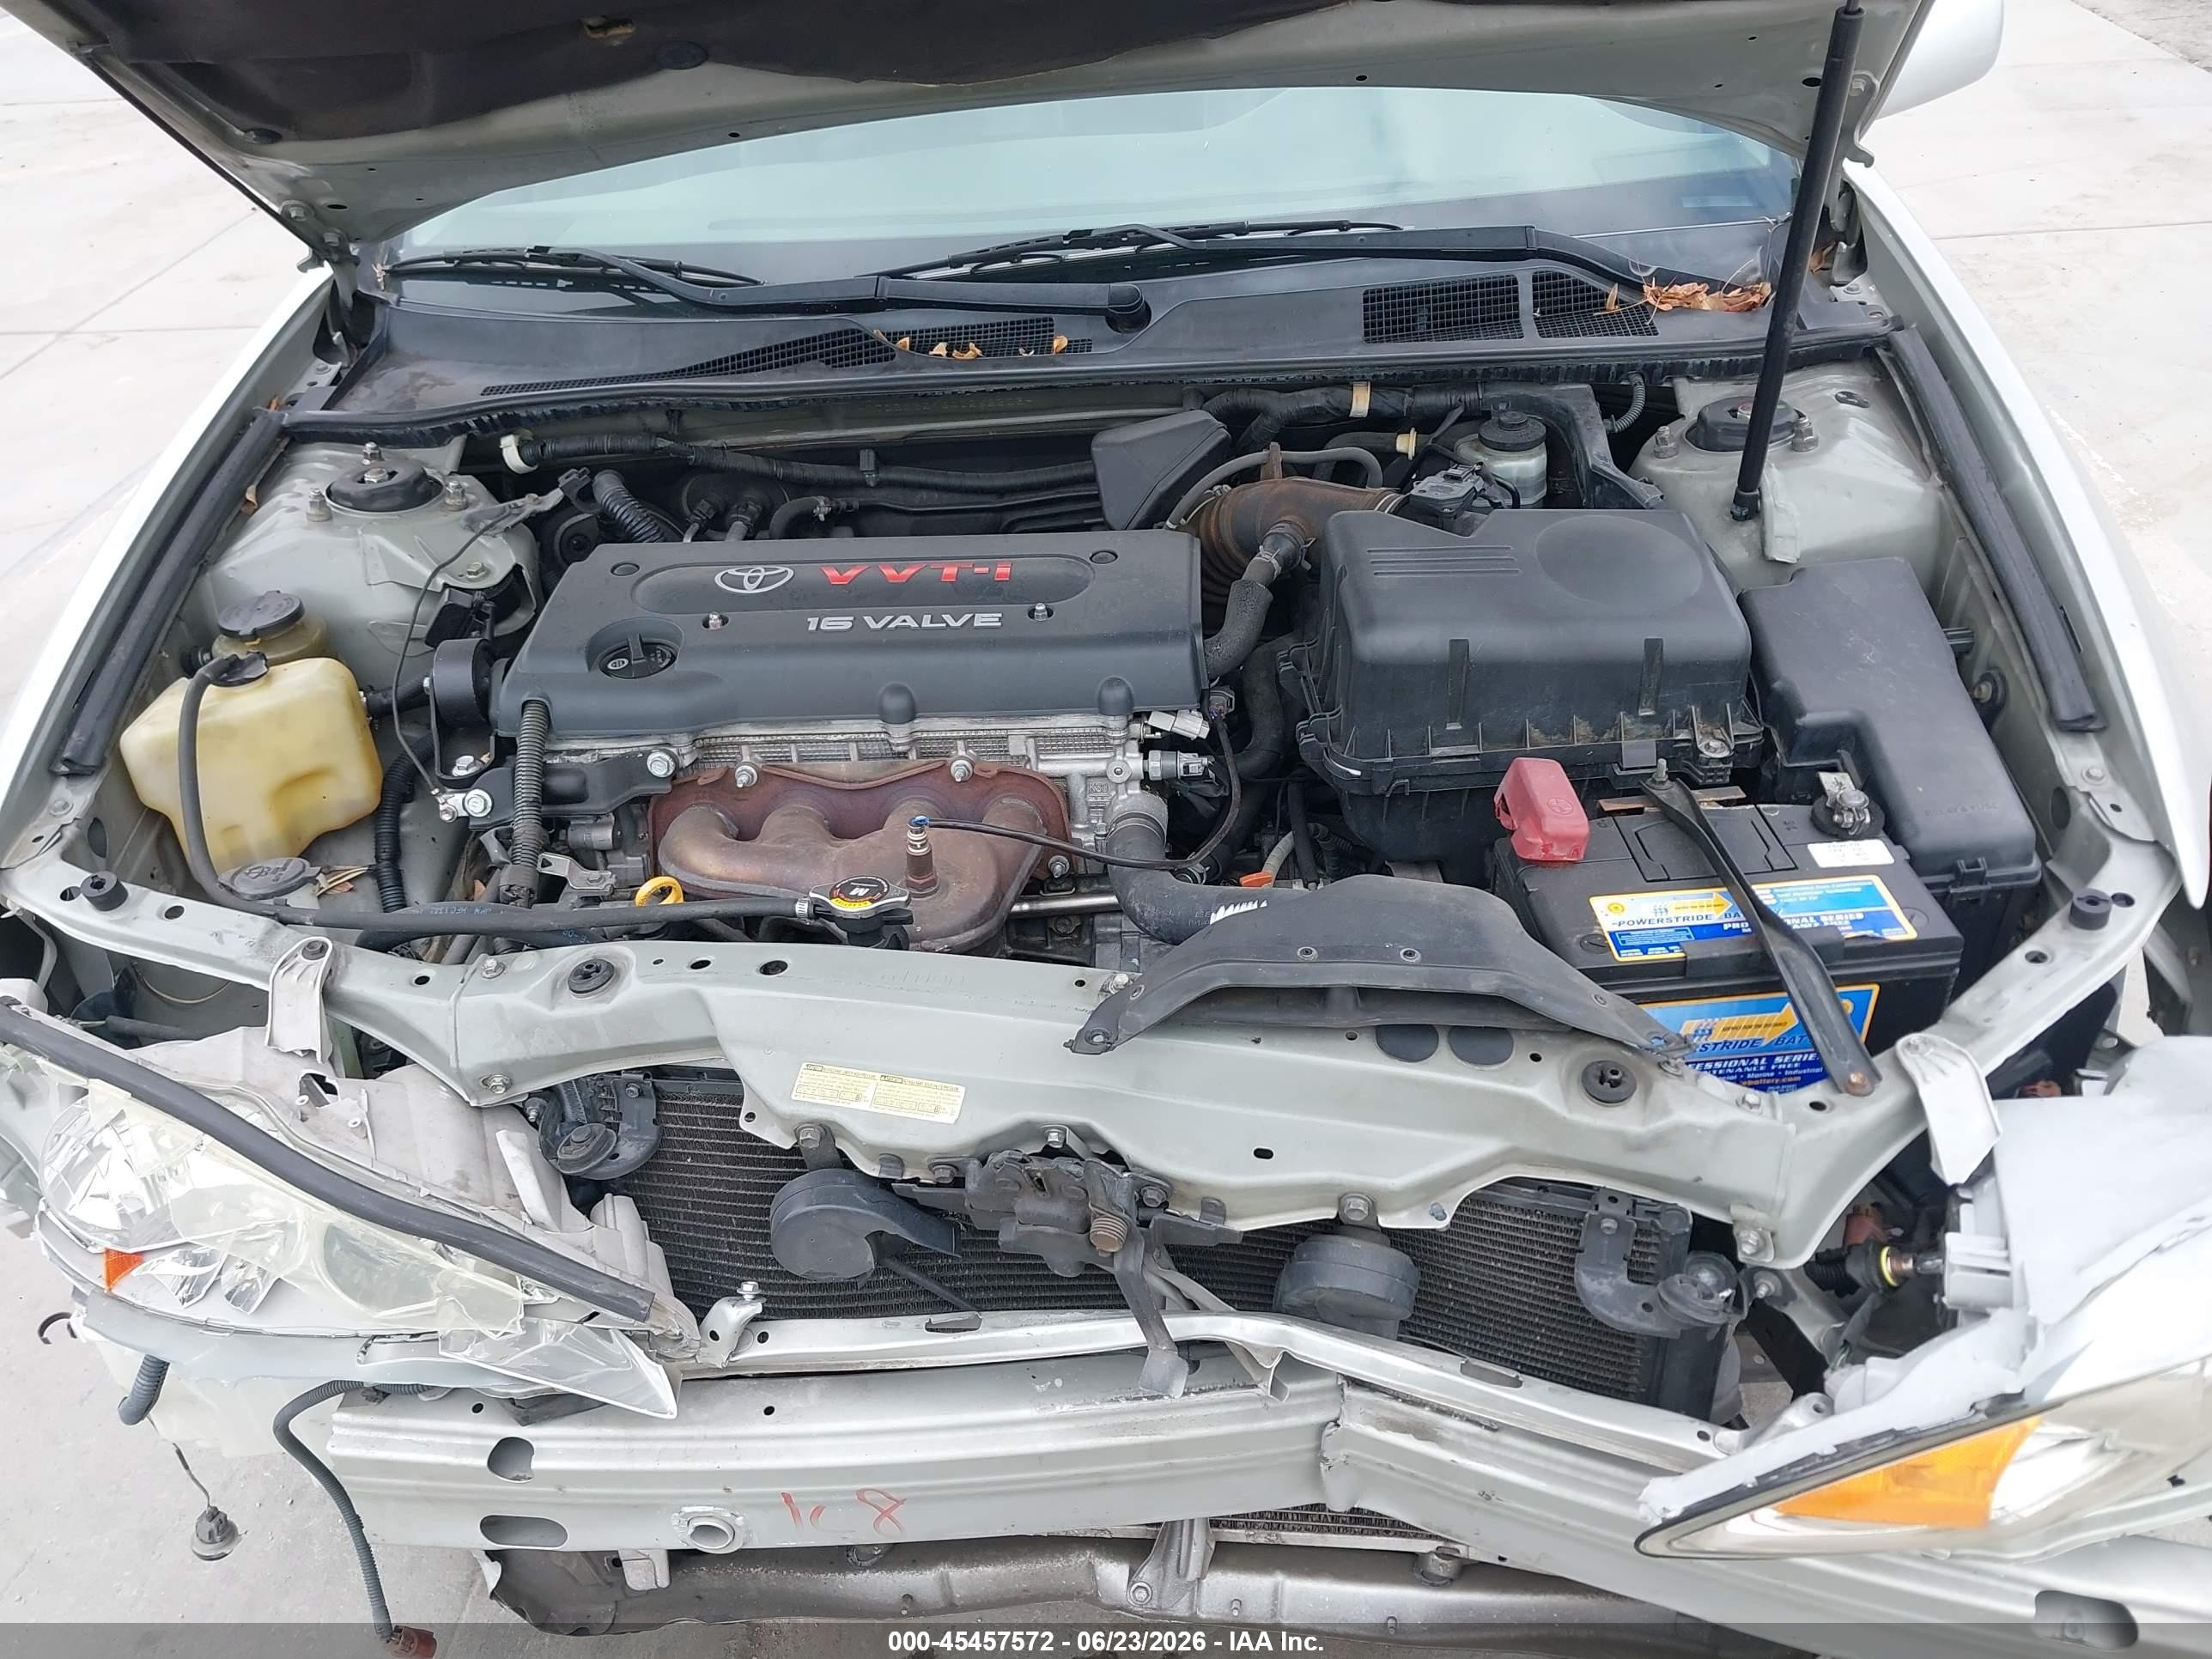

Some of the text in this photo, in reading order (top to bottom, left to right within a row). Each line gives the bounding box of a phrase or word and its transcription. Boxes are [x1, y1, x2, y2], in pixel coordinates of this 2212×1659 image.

[807, 613, 1003, 630] 16 VALVE
[1617, 913, 1713, 927] POWERSTRIDE
[1698, 1039, 1761, 1053] STRIDE
[1688, 1053, 1820, 1070] FESSIONAL SERIE
[1704, 1066, 1765, 1075] NTENANCE
